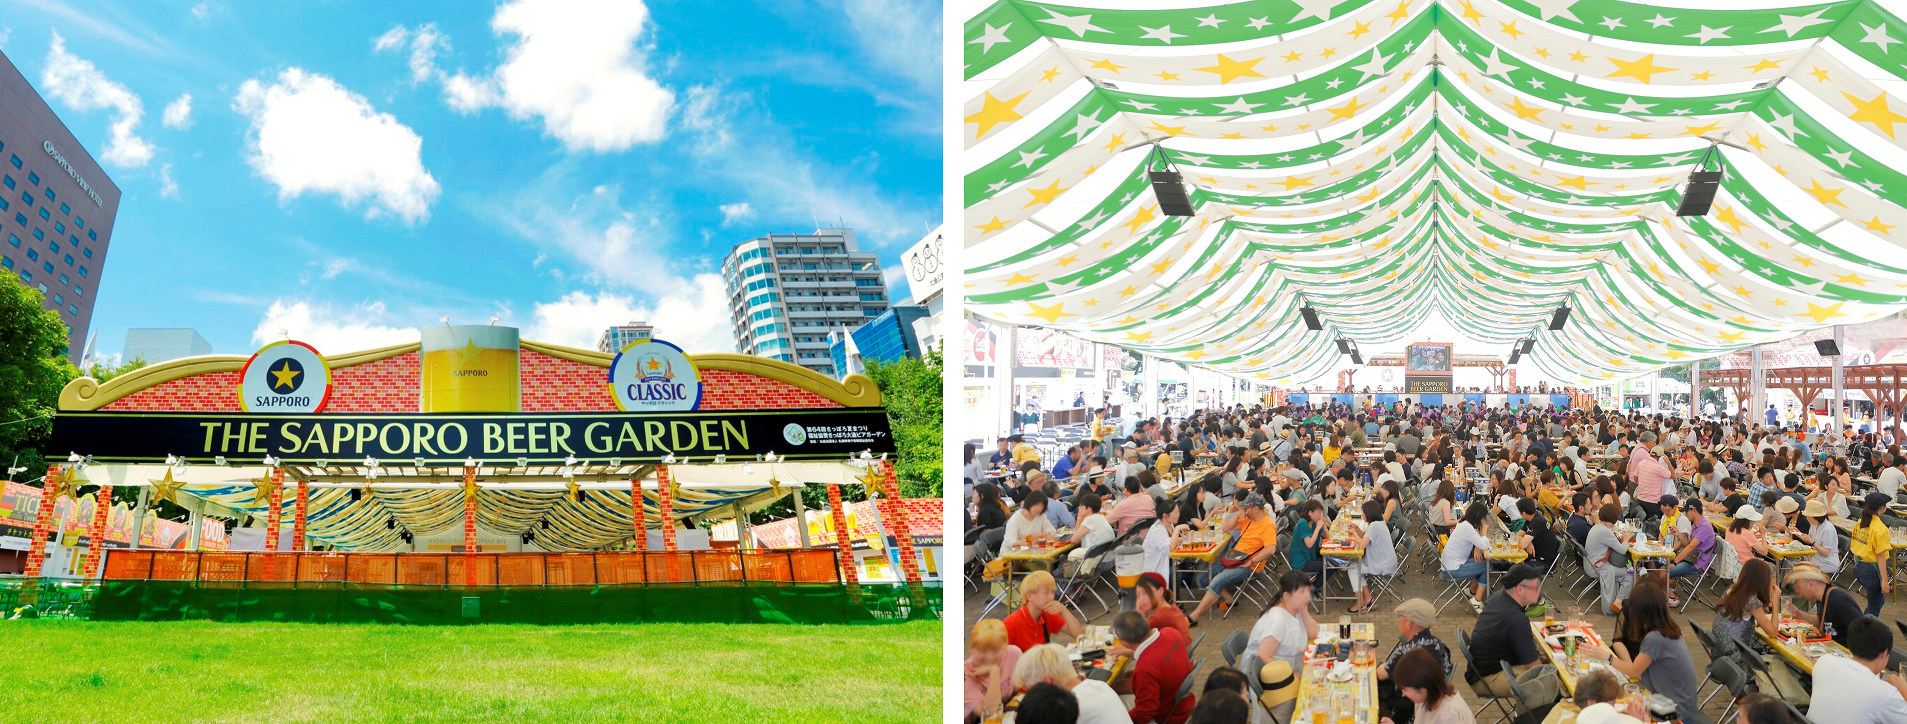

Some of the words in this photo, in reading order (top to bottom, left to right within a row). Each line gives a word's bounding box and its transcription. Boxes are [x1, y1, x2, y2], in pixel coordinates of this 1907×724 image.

[53, 151, 77, 178] SAPPORO
[76, 174, 90, 191] VIEW
[88, 188, 103, 208] HOTEL
[453, 369, 488, 377] SAPPORO
[627, 383, 687, 401] CLASSIC
[255, 396, 311, 407] SAPPORO
[200, 422, 270, 453] THE
[279, 422, 469, 456] SAPPORO
[484, 422, 577, 454] BEER
[584, 420, 750, 453] GARDEN
